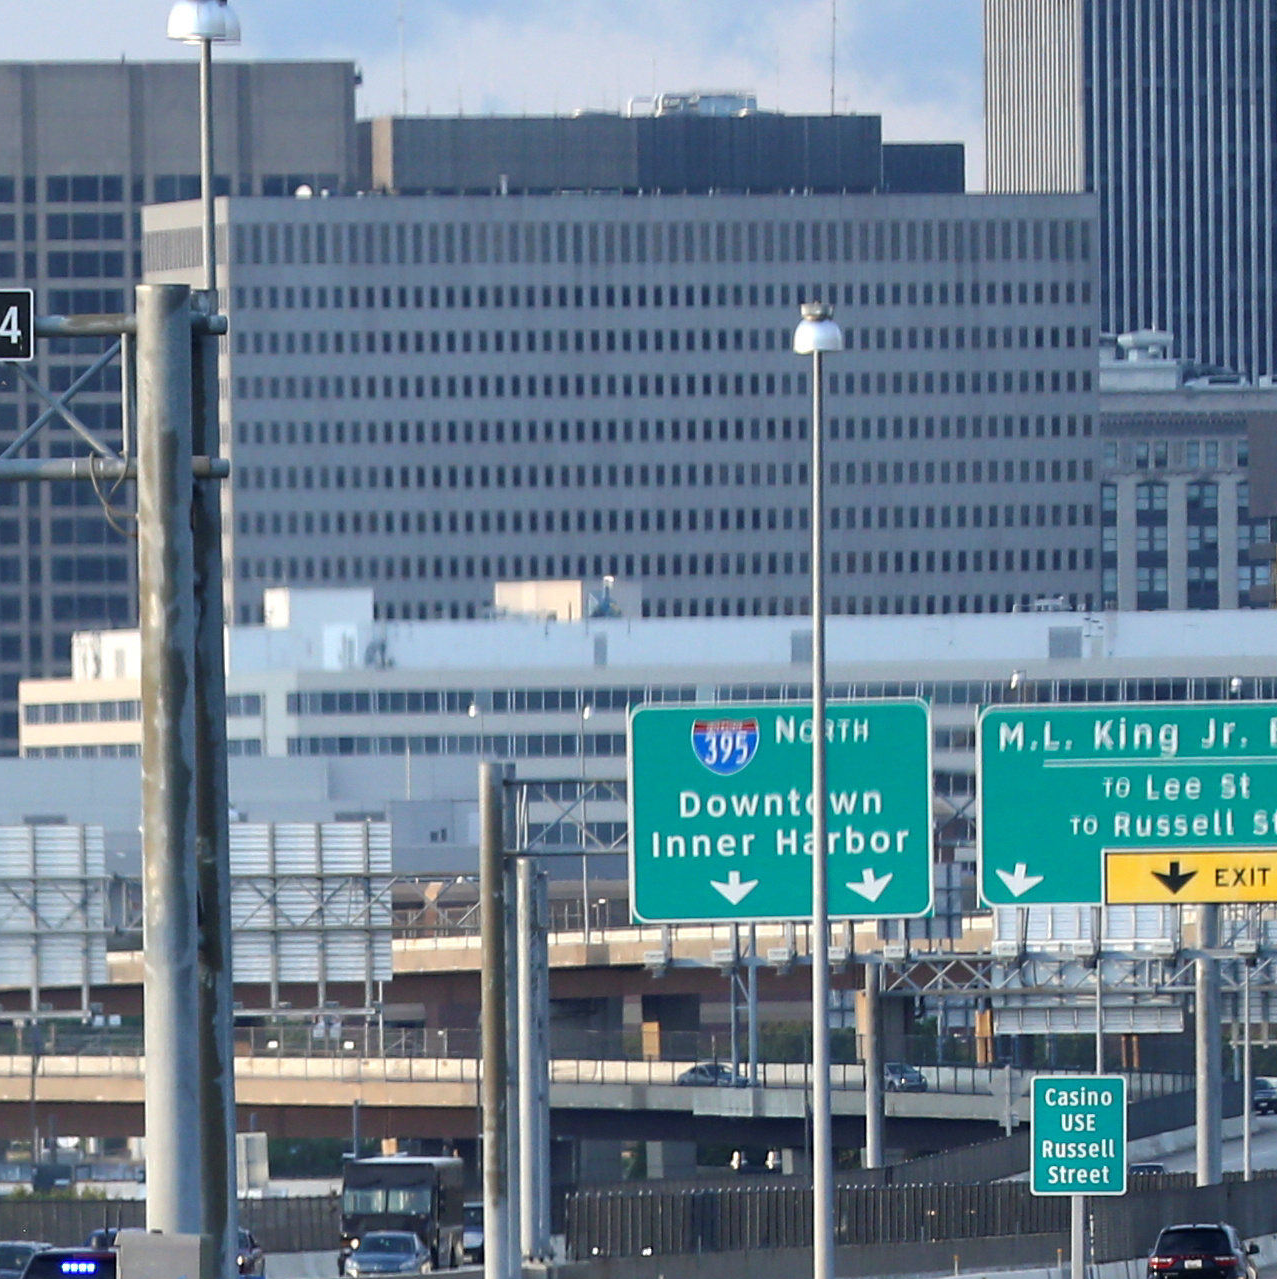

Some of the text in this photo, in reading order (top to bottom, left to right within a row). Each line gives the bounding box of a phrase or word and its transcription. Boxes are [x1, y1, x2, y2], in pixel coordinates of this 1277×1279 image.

[704, 730, 749, 766] 395
[775, 715, 870, 745] NORTH
[998, 719, 1073, 752] M.L.
[1093, 717, 1179, 757] King
[1201, 717, 1249, 748] Jr.
[1101, 772, 1251, 801] TO Lee St
[1070, 815, 1098, 835] TO
[1114, 808, 1235, 838] Russell
[650, 825, 909, 858] Inner Harbor
[1214, 867, 1271, 888] EXIT
[1045, 1087, 1113, 1106] Casino
[1060, 1114, 1096, 1132] USE
[1042, 1138, 1115, 1159] Russell
[1047, 1165, 1110, 1184] Street
